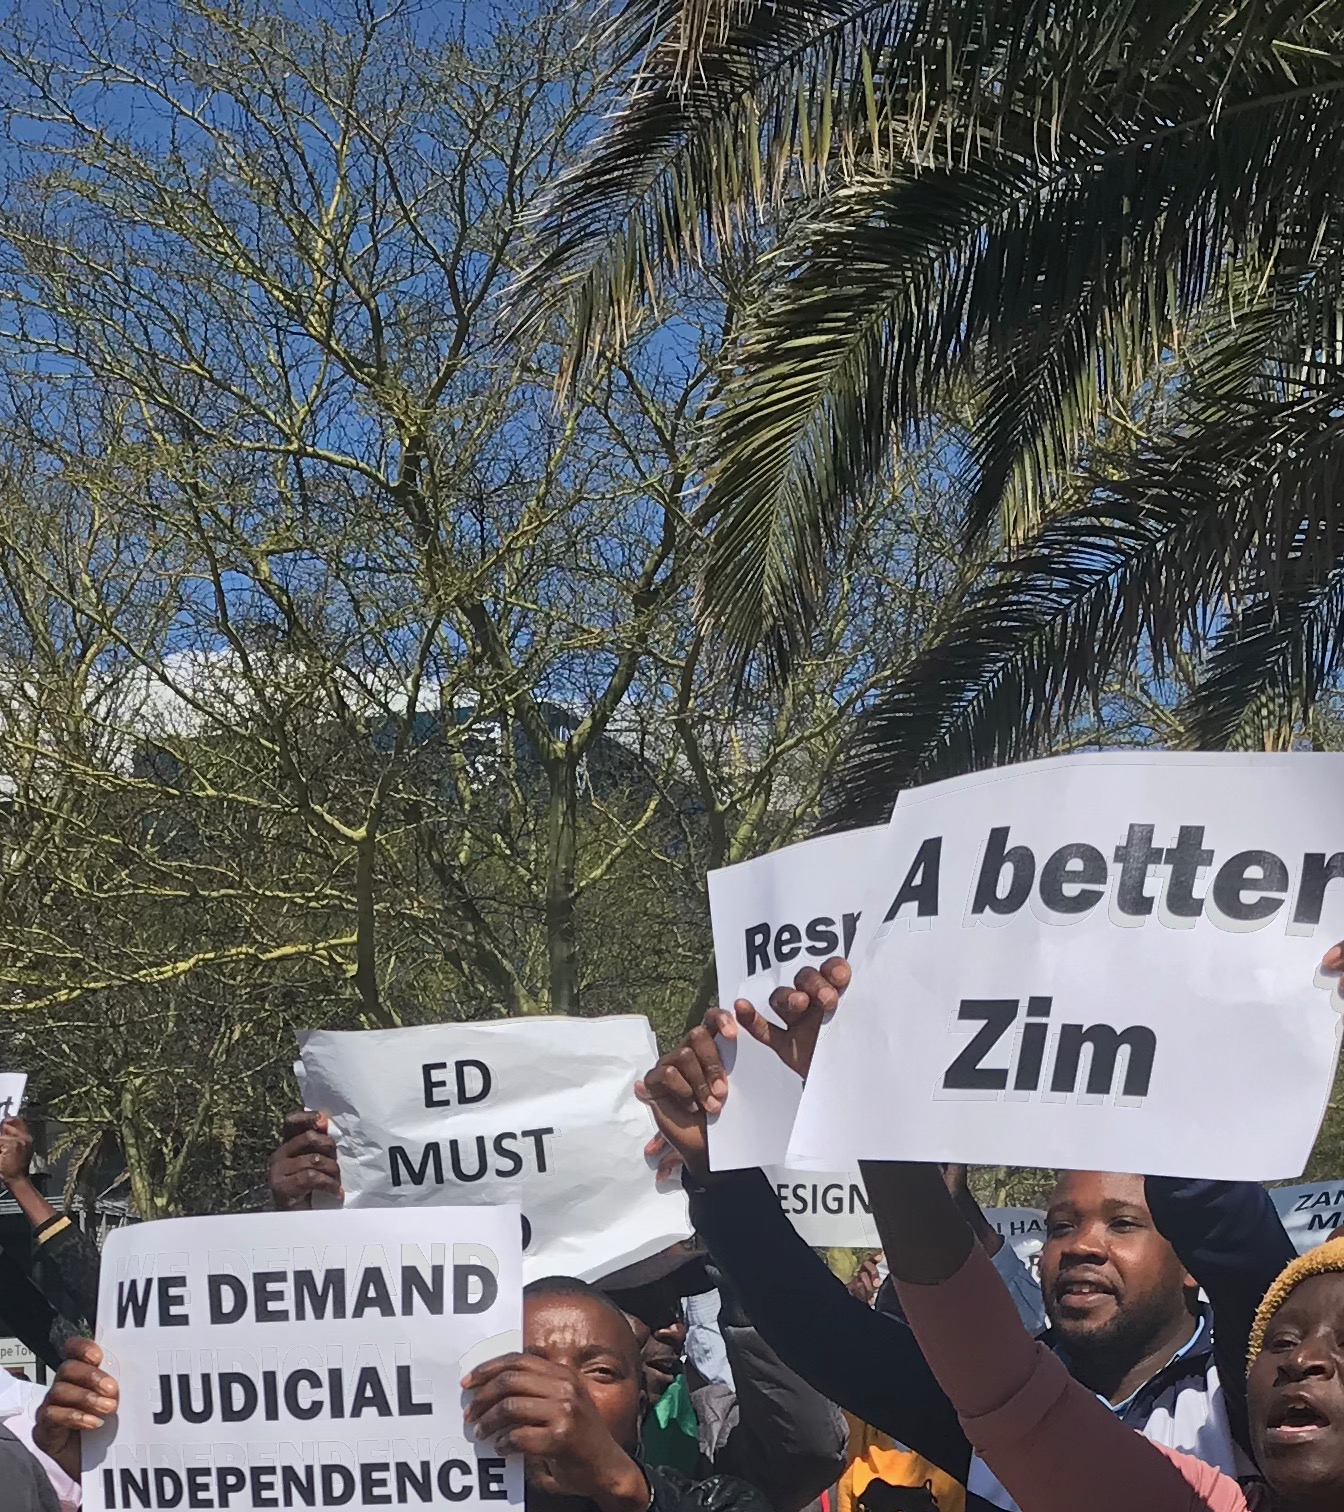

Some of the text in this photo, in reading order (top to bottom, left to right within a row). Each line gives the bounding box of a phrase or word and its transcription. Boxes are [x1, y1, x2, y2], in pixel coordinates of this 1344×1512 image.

[884, 835, 944, 923] A
[941, 996, 1158, 1099] Zim
[422, 1059, 492, 1109] ED
[388, 1127, 556, 1187] MUST
[777, 1183, 874, 1214] ESIGN
[1010, 1219, 1047, 1235] HA
[115, 1263, 500, 1329] WE DEMAND
[14, 1345, 32, 1356] To
[152, 1364, 433, 1425] JUDICIAL
[103, 1456, 509, 1510] INDEPENDENCE
